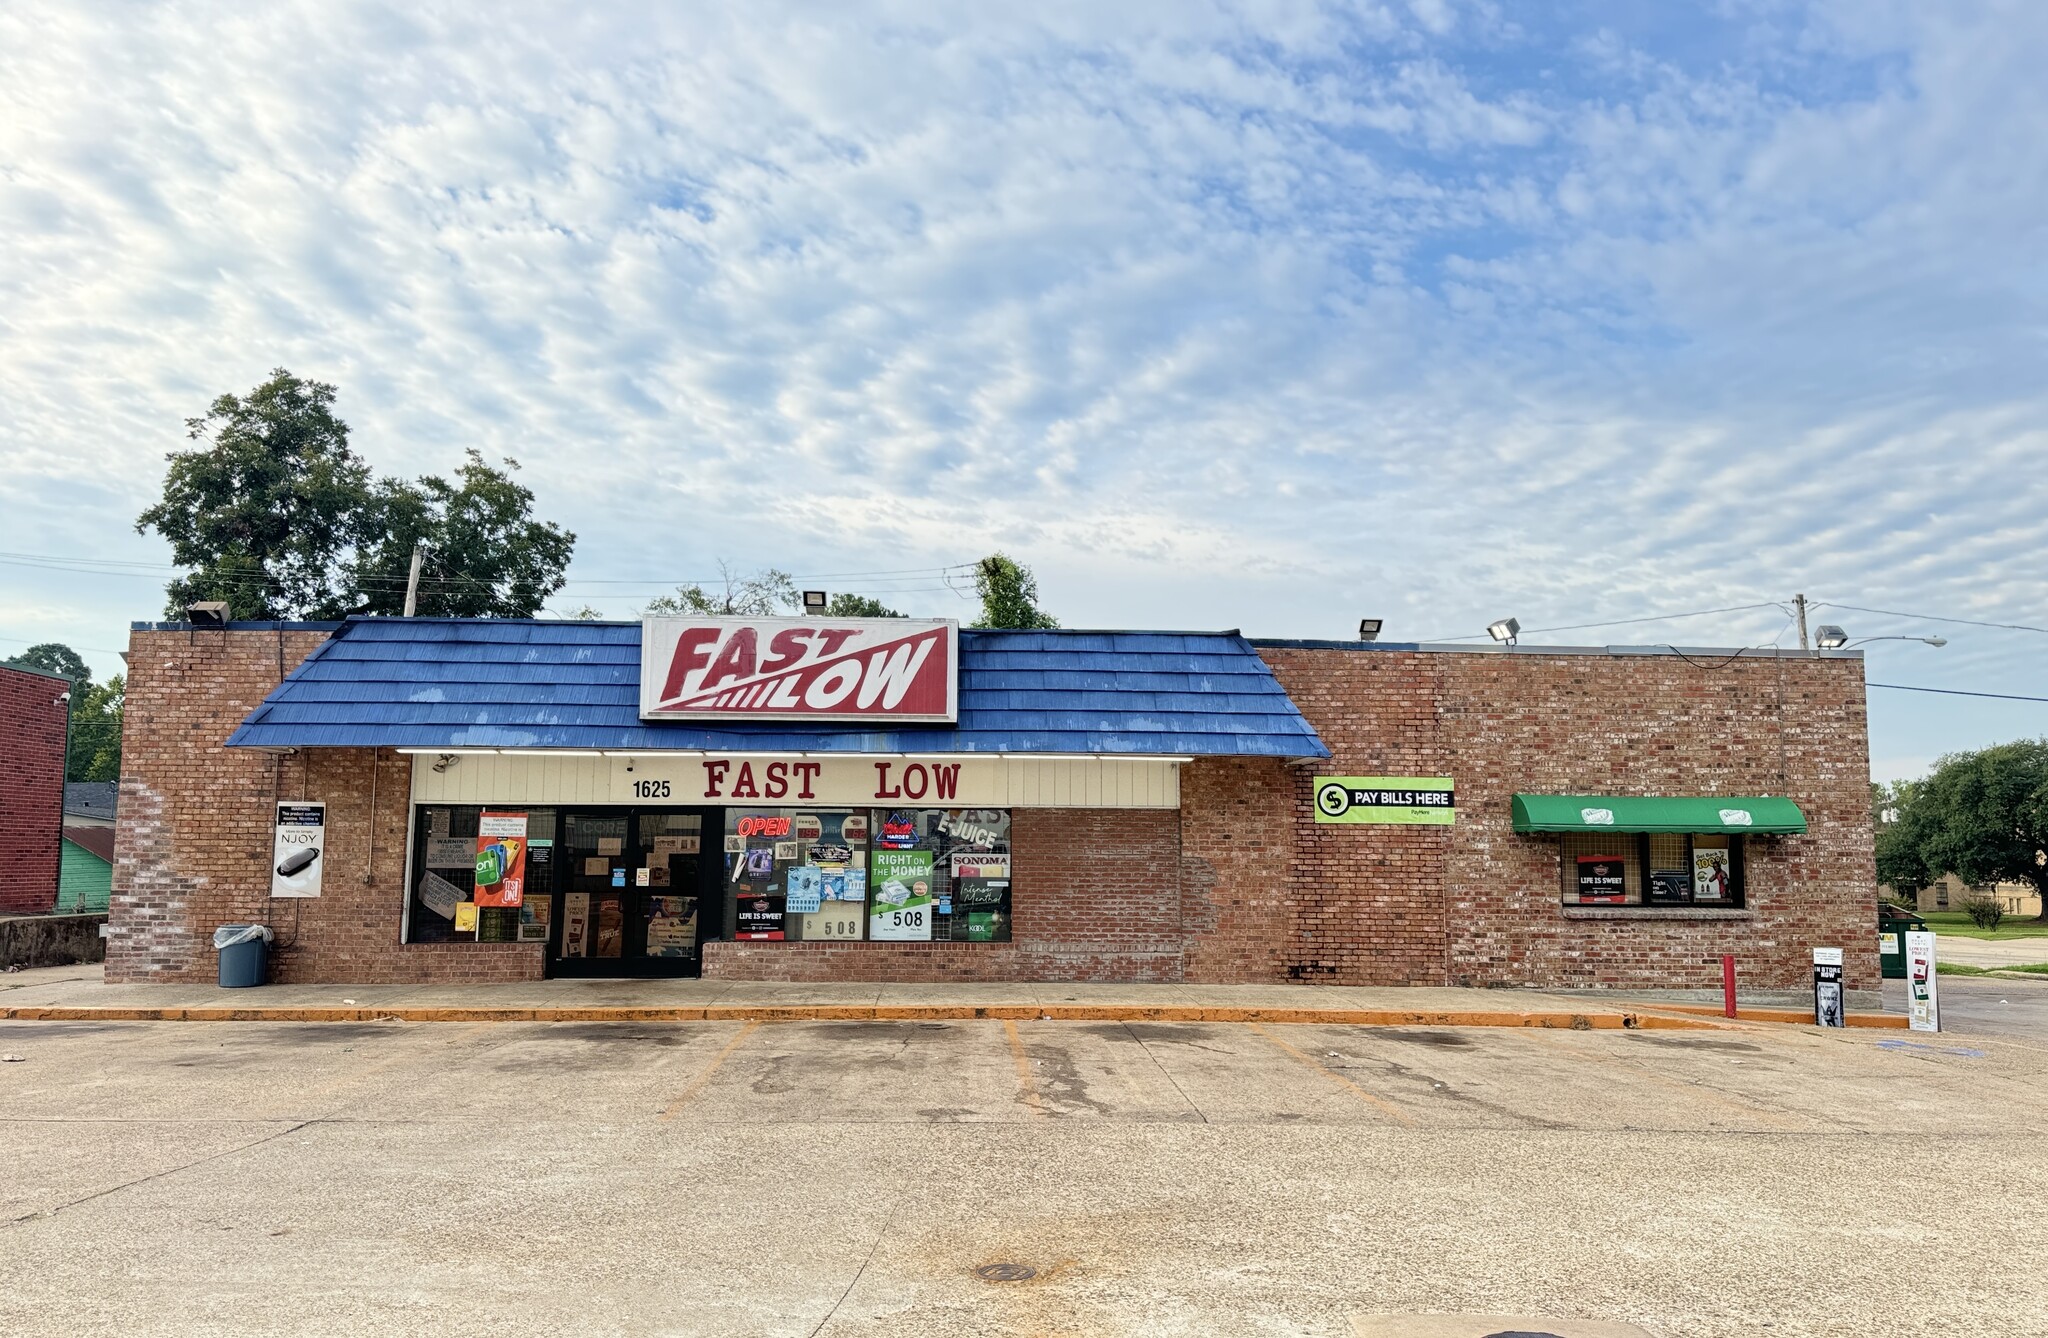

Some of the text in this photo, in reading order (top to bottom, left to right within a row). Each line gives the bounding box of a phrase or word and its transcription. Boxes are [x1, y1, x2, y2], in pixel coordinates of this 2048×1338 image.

[659, 627, 864, 702] FAST
[768, 636, 938, 710] LOW
[702, 760, 961, 799] FAST LOW
[633, 780, 671, 798] 1625
[1355, 792, 1449, 805] PAY BILLS HERE
[738, 817, 791, 837] OPEN
[938, 813, 998, 850] E-JUICE
[281, 834, 317, 844] NJOY
[877, 854, 925, 865] RIGHT ON
[953, 856, 1008, 865] SONOMA
[1696, 854, 1727, 870] 100%
[872, 865, 931, 877] THE MONEY
[960, 882, 993, 895] Intense
[964, 892, 1002, 905] Menthol
[739, 912, 783, 920] LIFE IS SWEET
[878, 911, 884, 919] $
[1821, 966, 1841, 974] STORE
